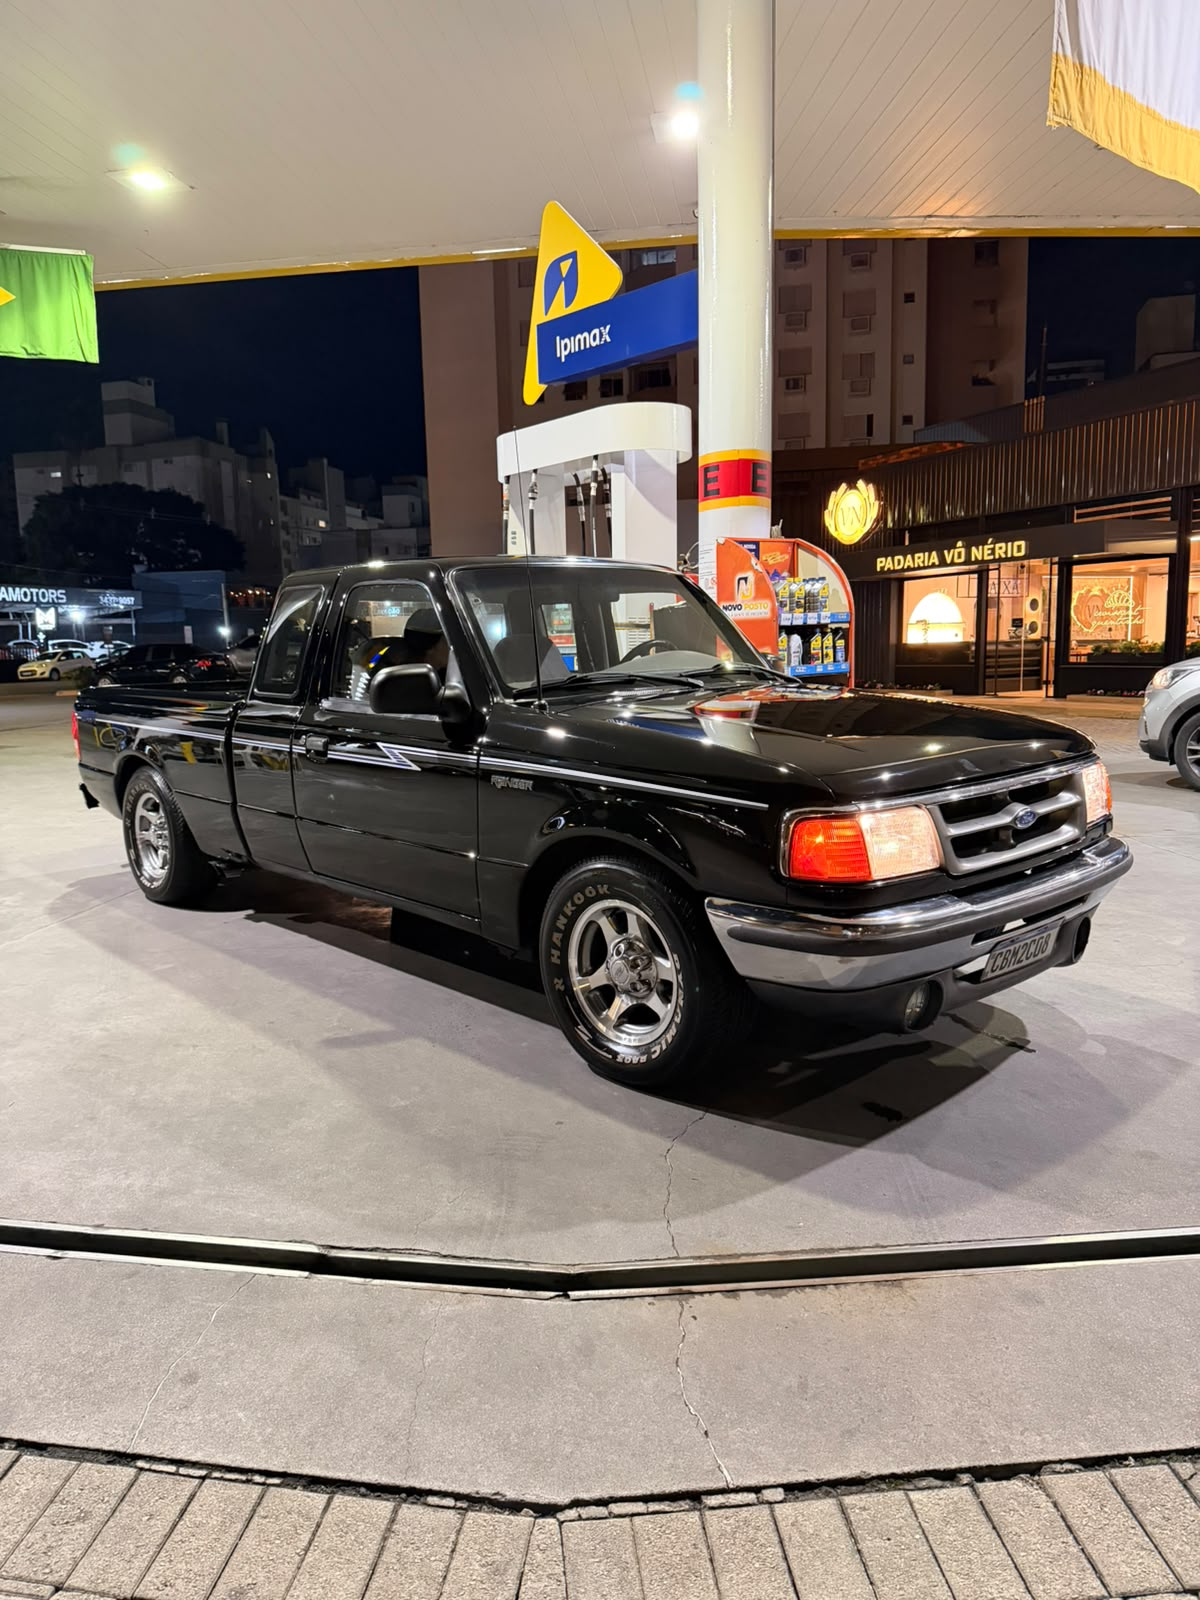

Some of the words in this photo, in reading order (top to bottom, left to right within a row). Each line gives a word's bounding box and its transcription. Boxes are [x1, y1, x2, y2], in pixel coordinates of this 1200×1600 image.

[556, 324, 611, 362] Ipimax
[703, 464, 720, 498] E
[751, 461, 767, 494] E
[876, 550, 939, 572] PADARIA
[943, 540, 966, 565] VÔ
[971, 538, 1026, 562] NÉRIO
[722, 603, 743, 612] NOVO
[744, 602, 769, 611] POSTO
[550, 884, 610, 965] HANKOOK
